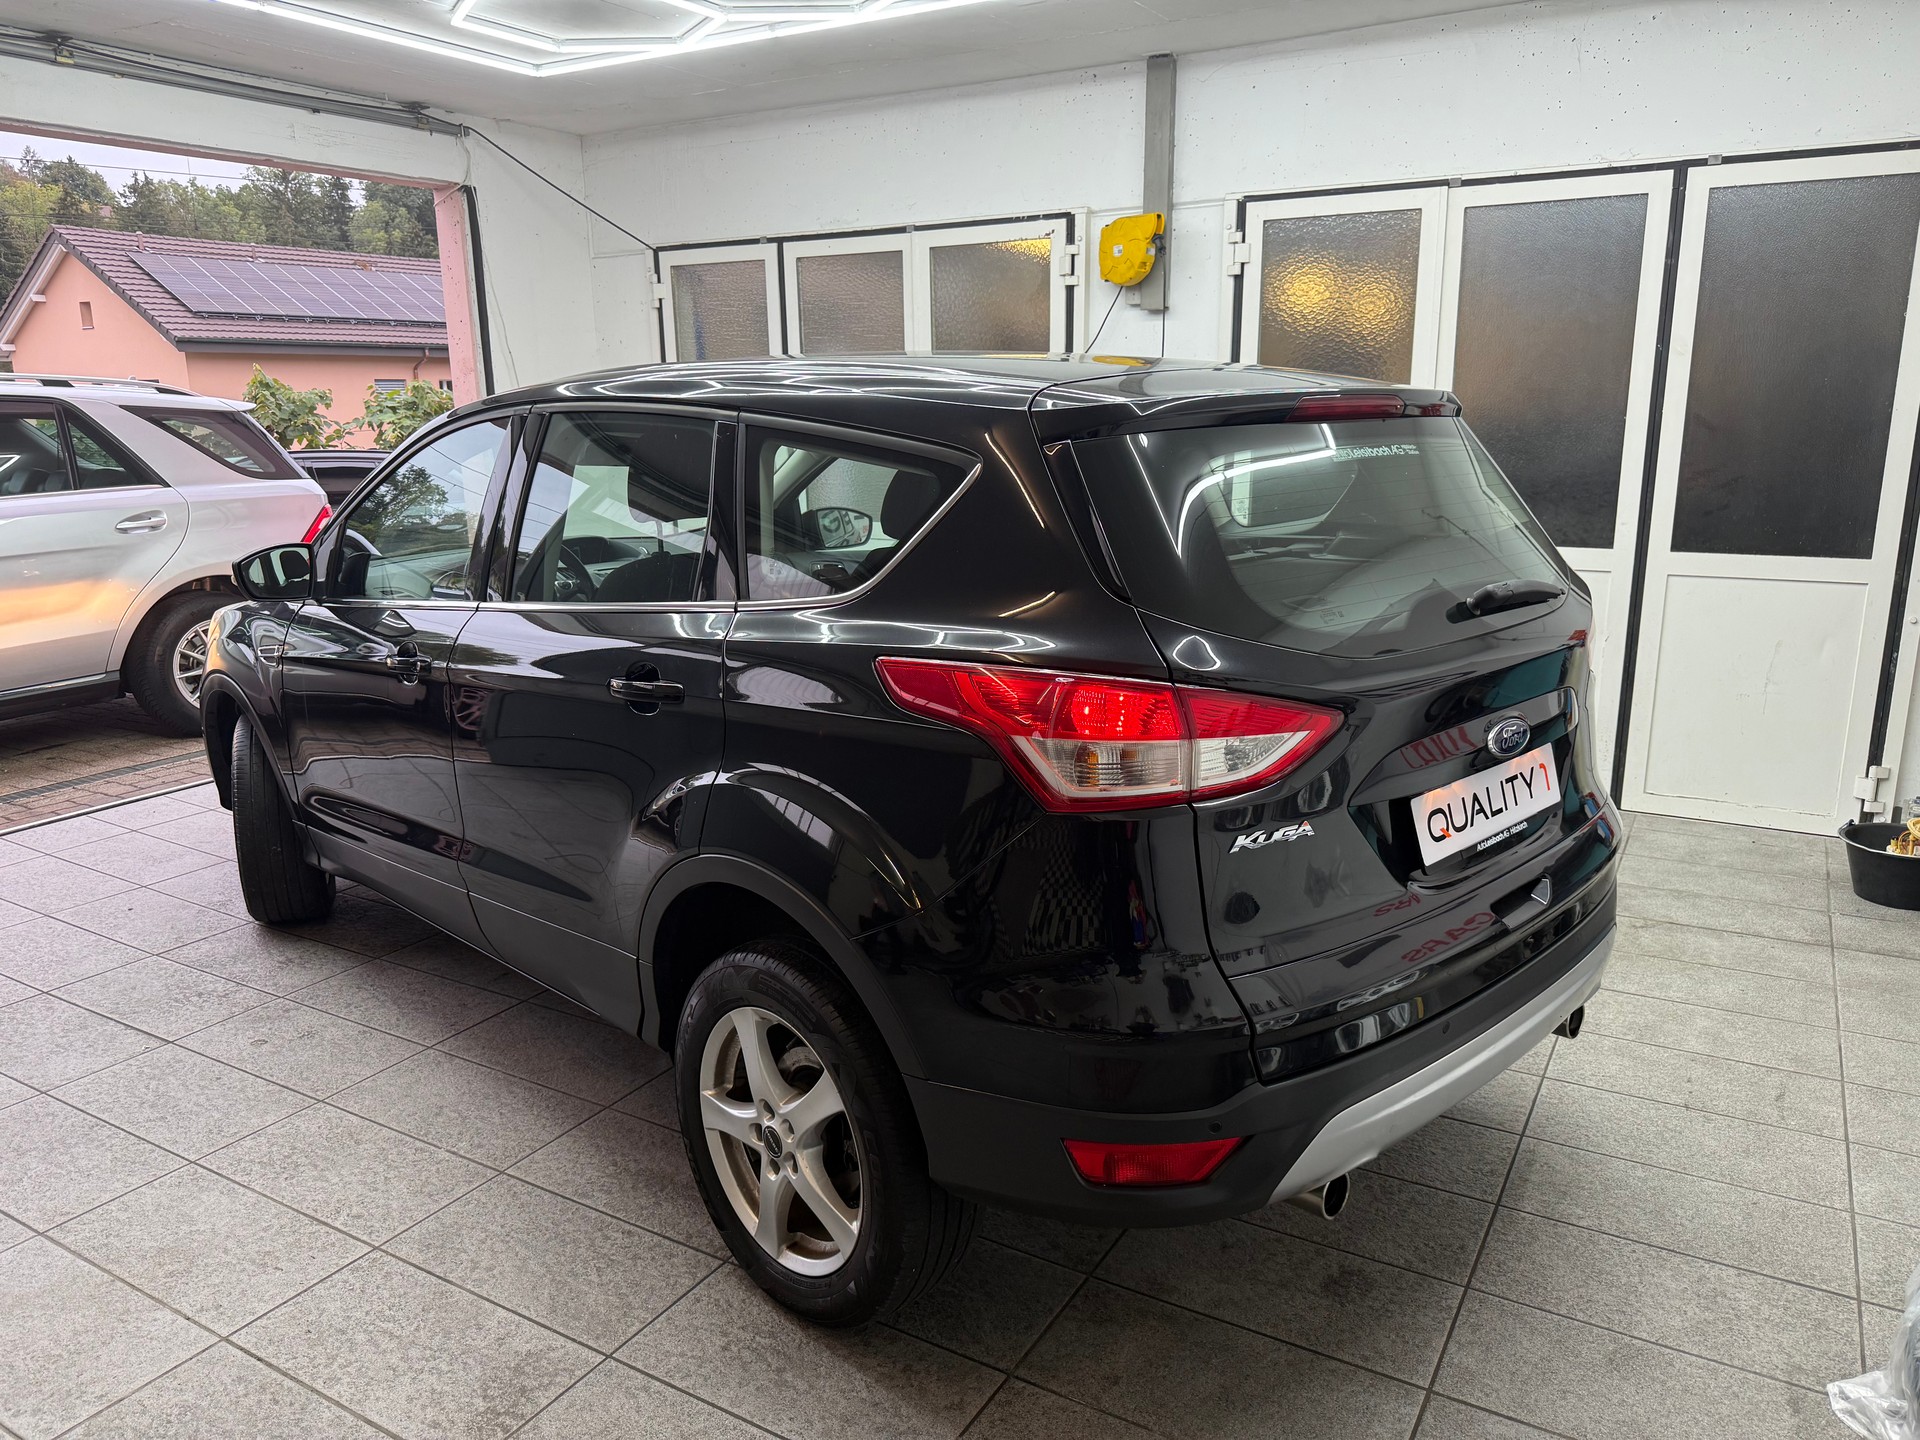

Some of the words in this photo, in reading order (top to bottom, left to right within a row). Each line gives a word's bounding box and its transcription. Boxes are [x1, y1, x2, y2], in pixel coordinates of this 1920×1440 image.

[1502, 725, 1526, 749] Ford
[1427, 766, 1534, 843] QUALITY
[1539, 763, 1550, 791] 1
[1229, 820, 1315, 854] KUGA
